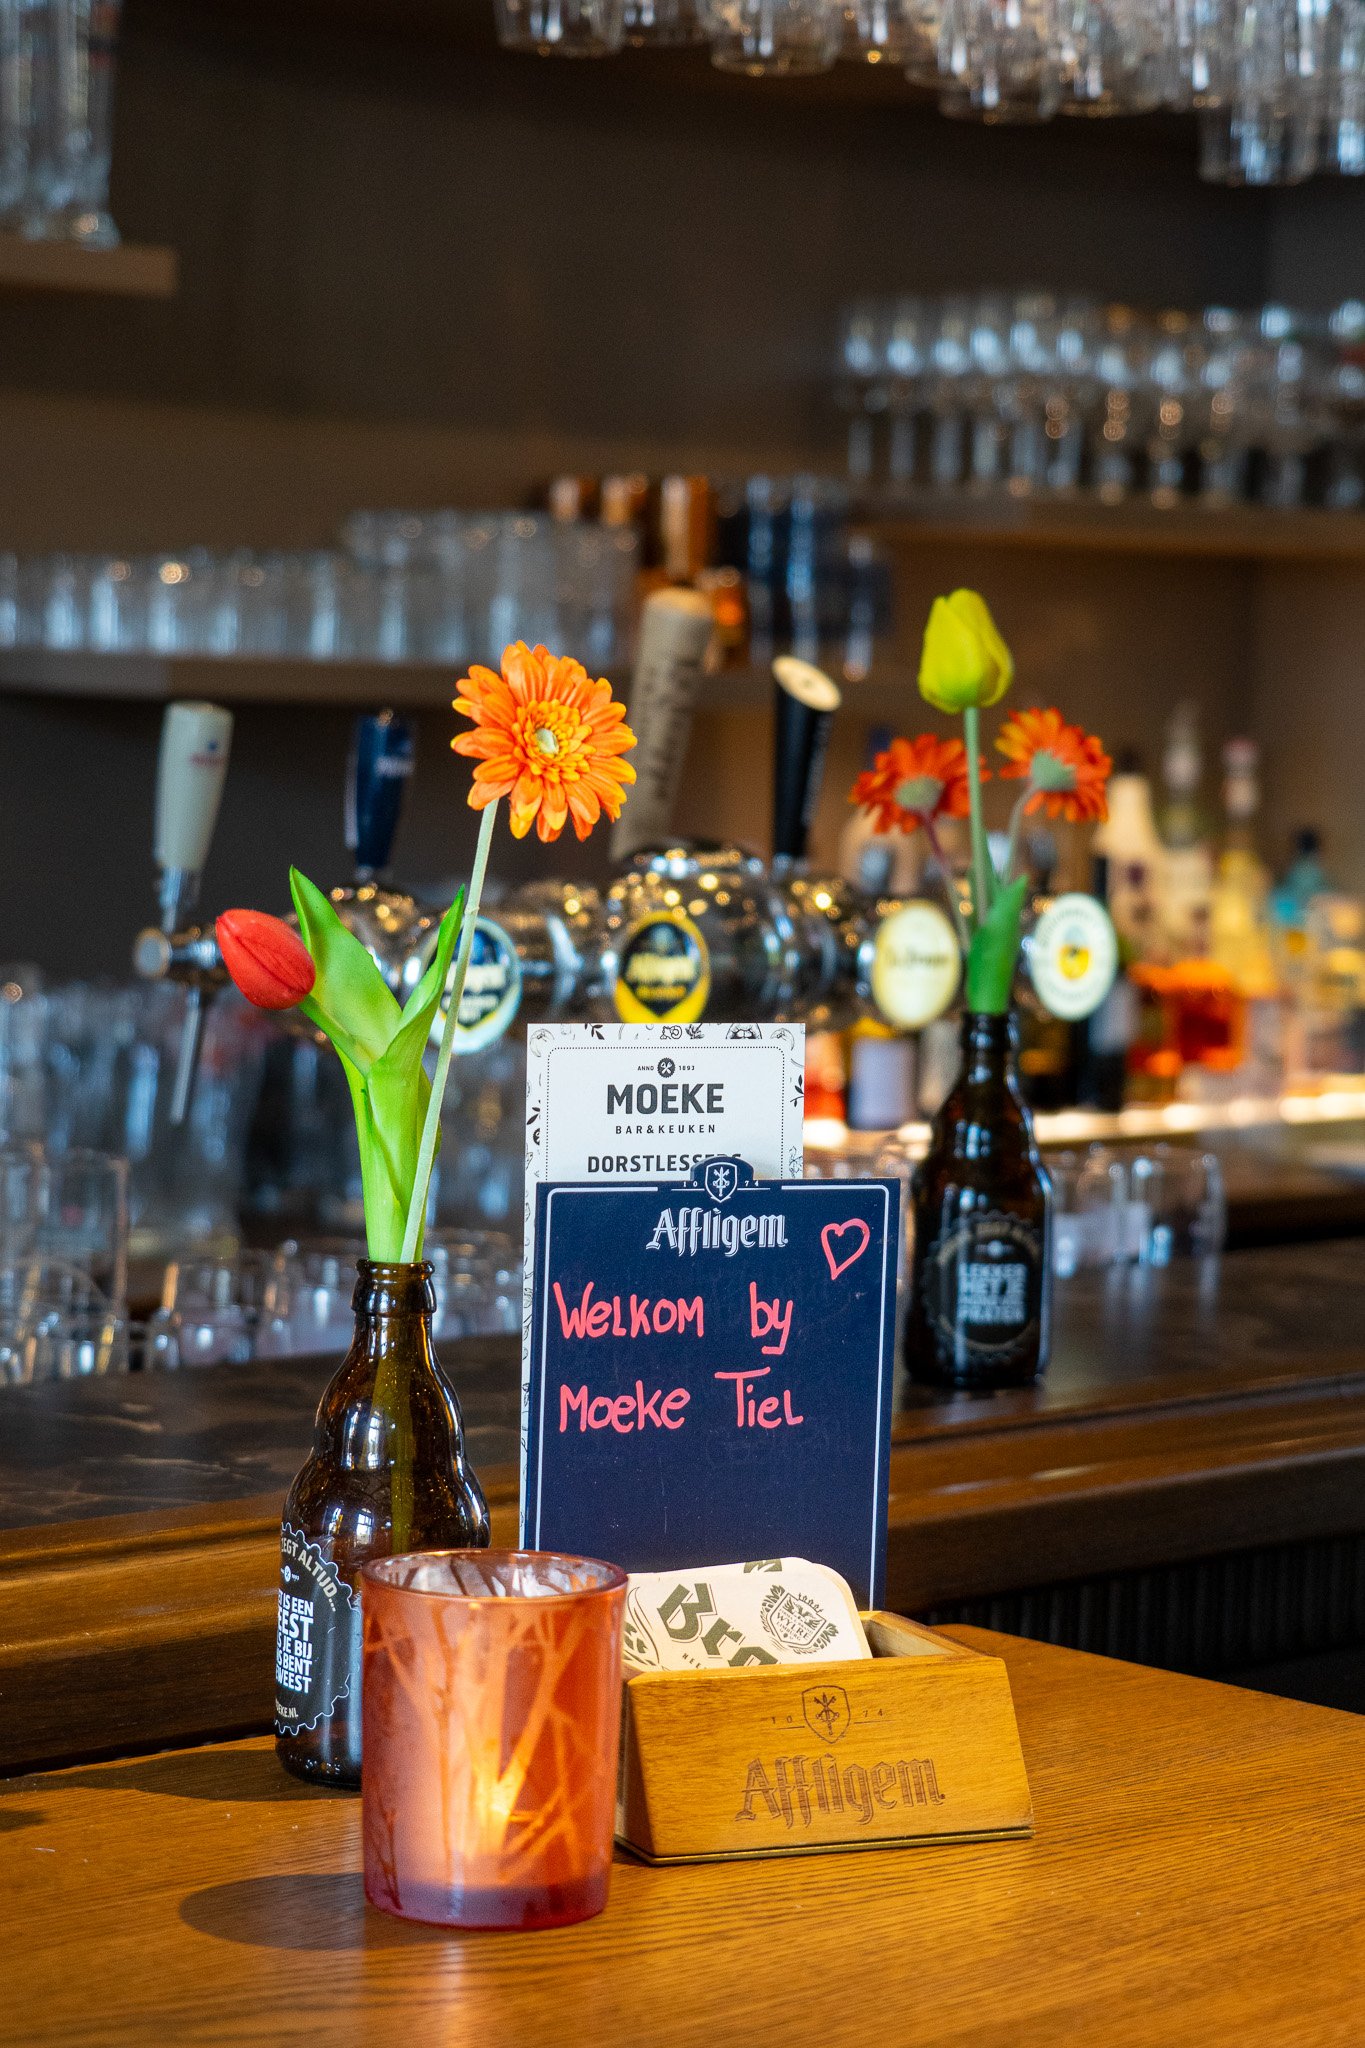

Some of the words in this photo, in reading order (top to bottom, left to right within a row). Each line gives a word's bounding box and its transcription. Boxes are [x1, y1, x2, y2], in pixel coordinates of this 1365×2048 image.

[607, 1083, 724, 1115] MOEKE
[615, 1124, 716, 1134] BAR&KEUKEN
[645, 1206, 789, 1257] Affligem
[749, 1281, 793, 1355] by
[558, 1380, 691, 1434] Moeke
[291, 1596, 314, 1617] EEN
[282, 1652, 313, 1677] BENT
[294, 1639, 313, 1660] BIJ
[735, 1753, 946, 1829] Affligem
